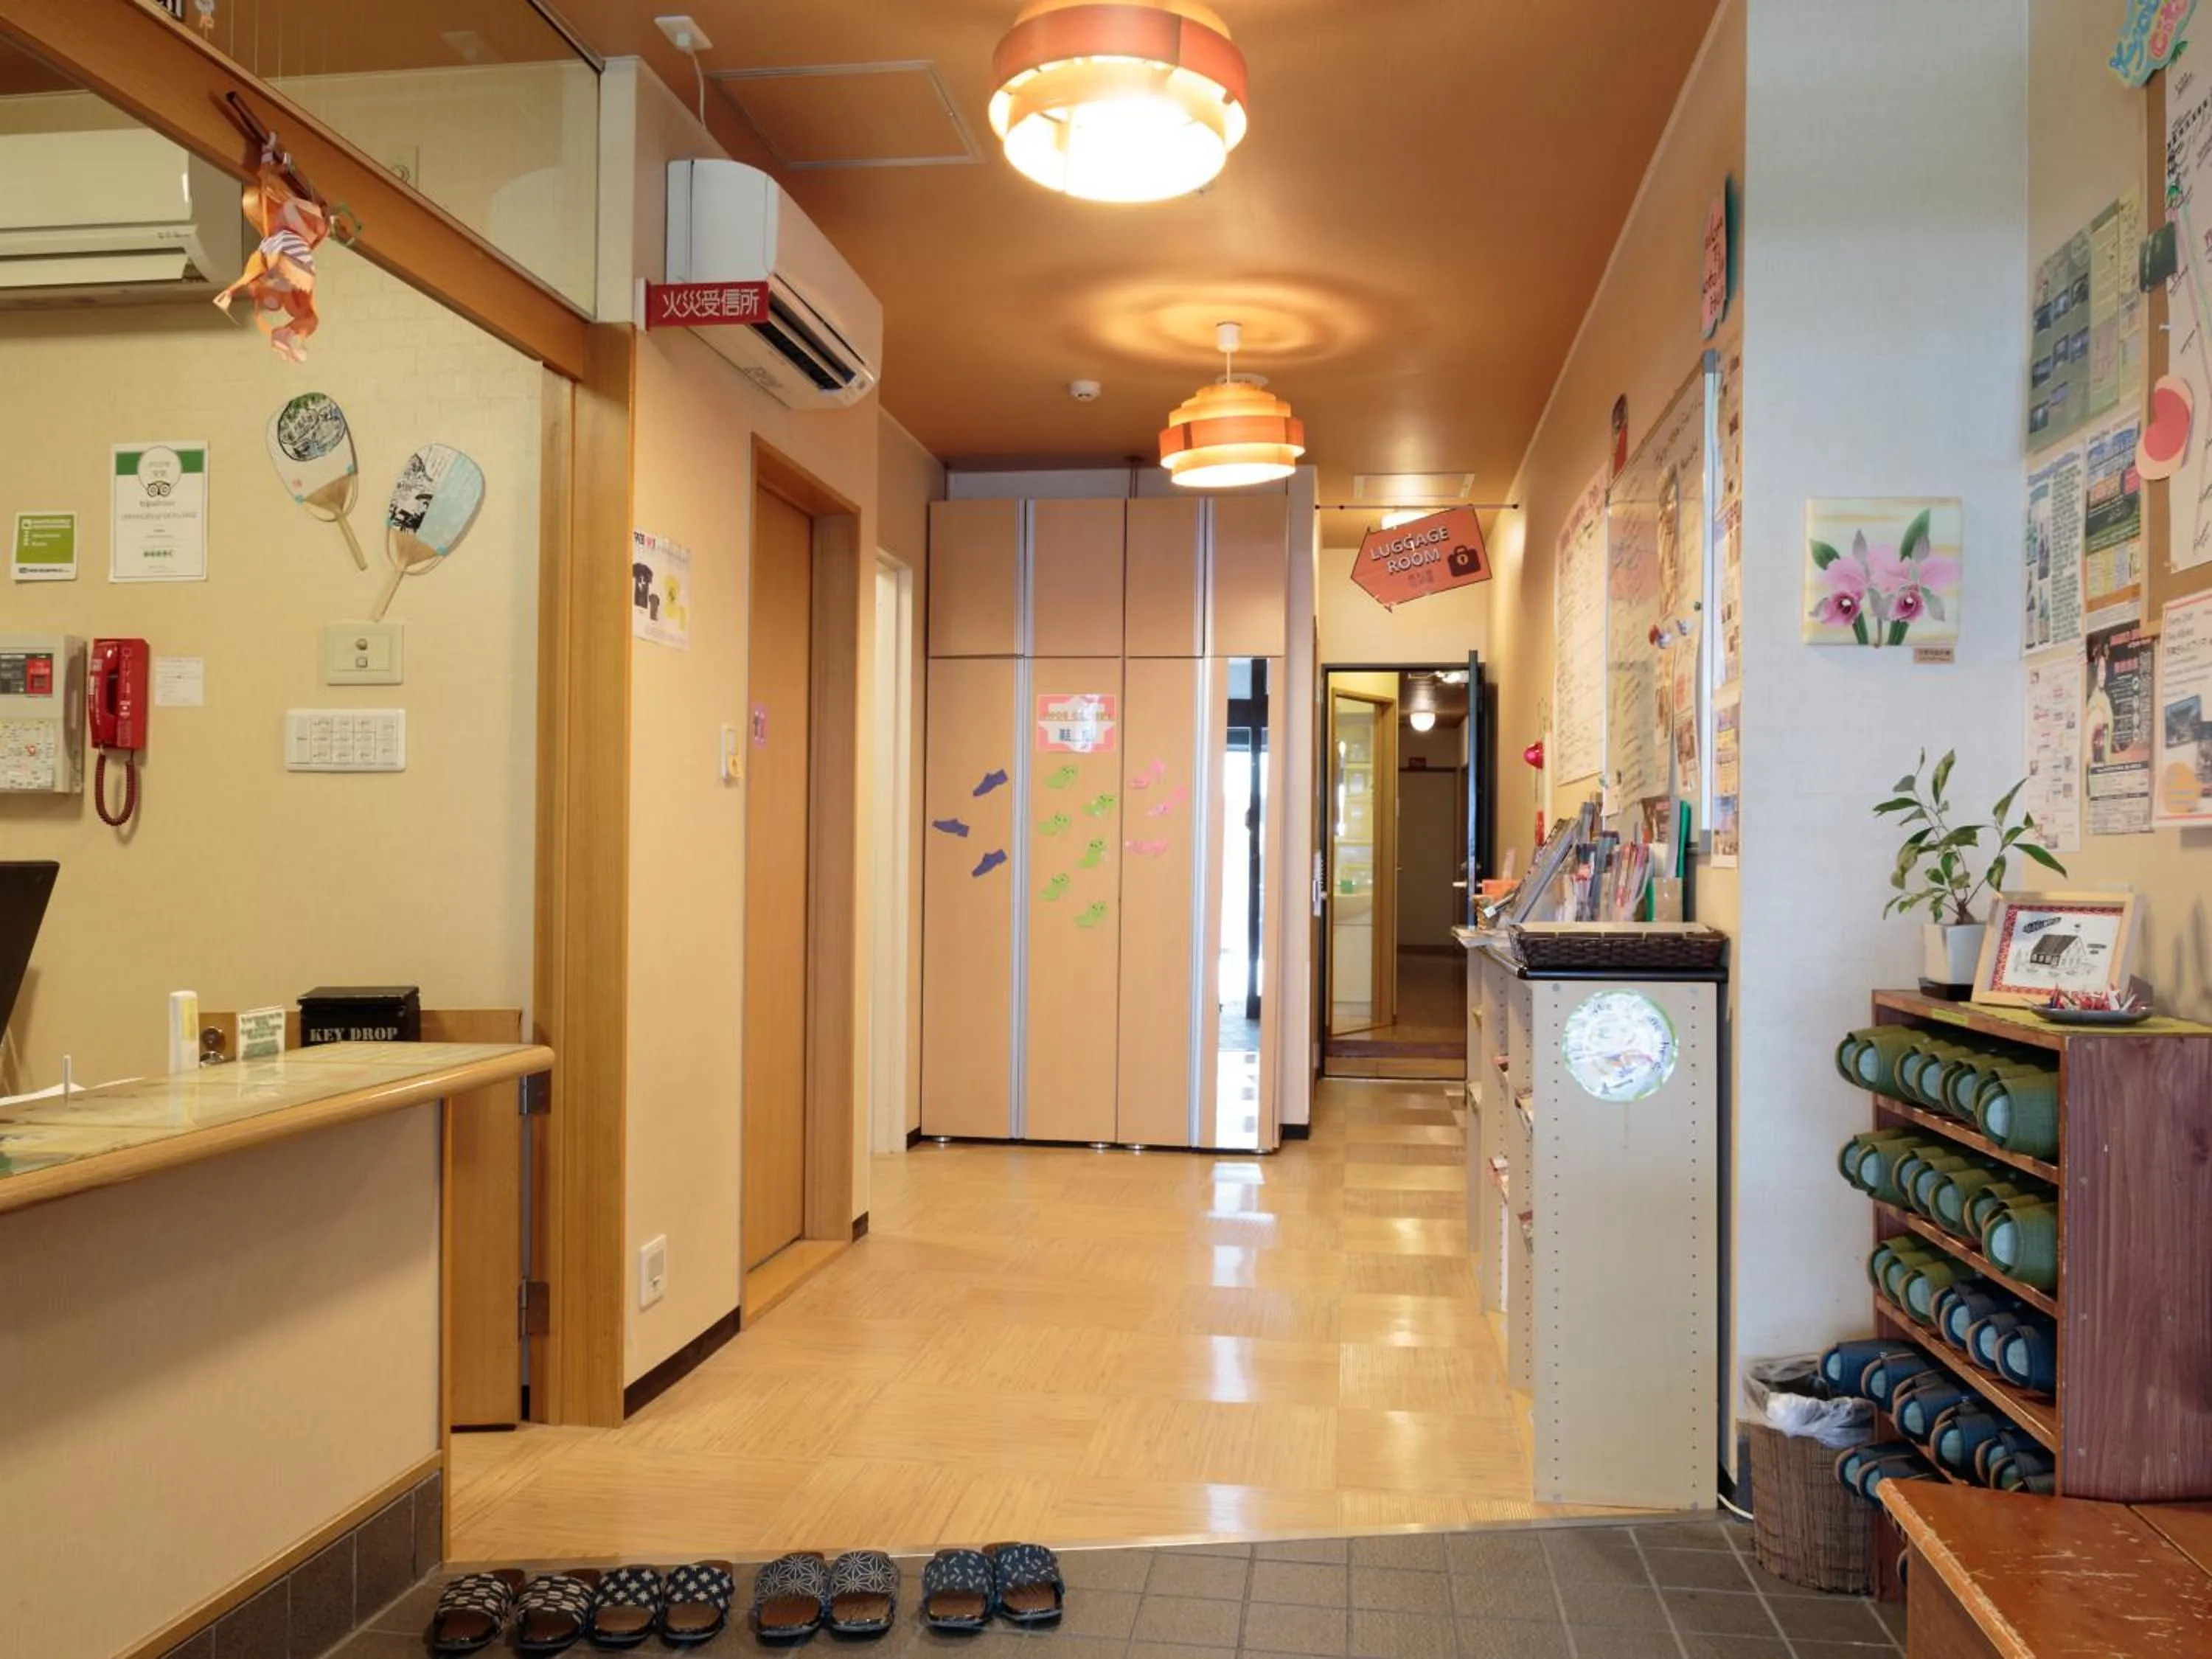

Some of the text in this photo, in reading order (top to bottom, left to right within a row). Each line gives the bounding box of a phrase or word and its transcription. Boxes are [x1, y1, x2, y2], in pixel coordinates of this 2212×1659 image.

[661, 288, 760, 319] 火災受信所
[1370, 526, 1450, 560] LUGGAGE
[1387, 548, 1441, 575] ROOM
[310, 1026, 398, 1042] KEY DROP
